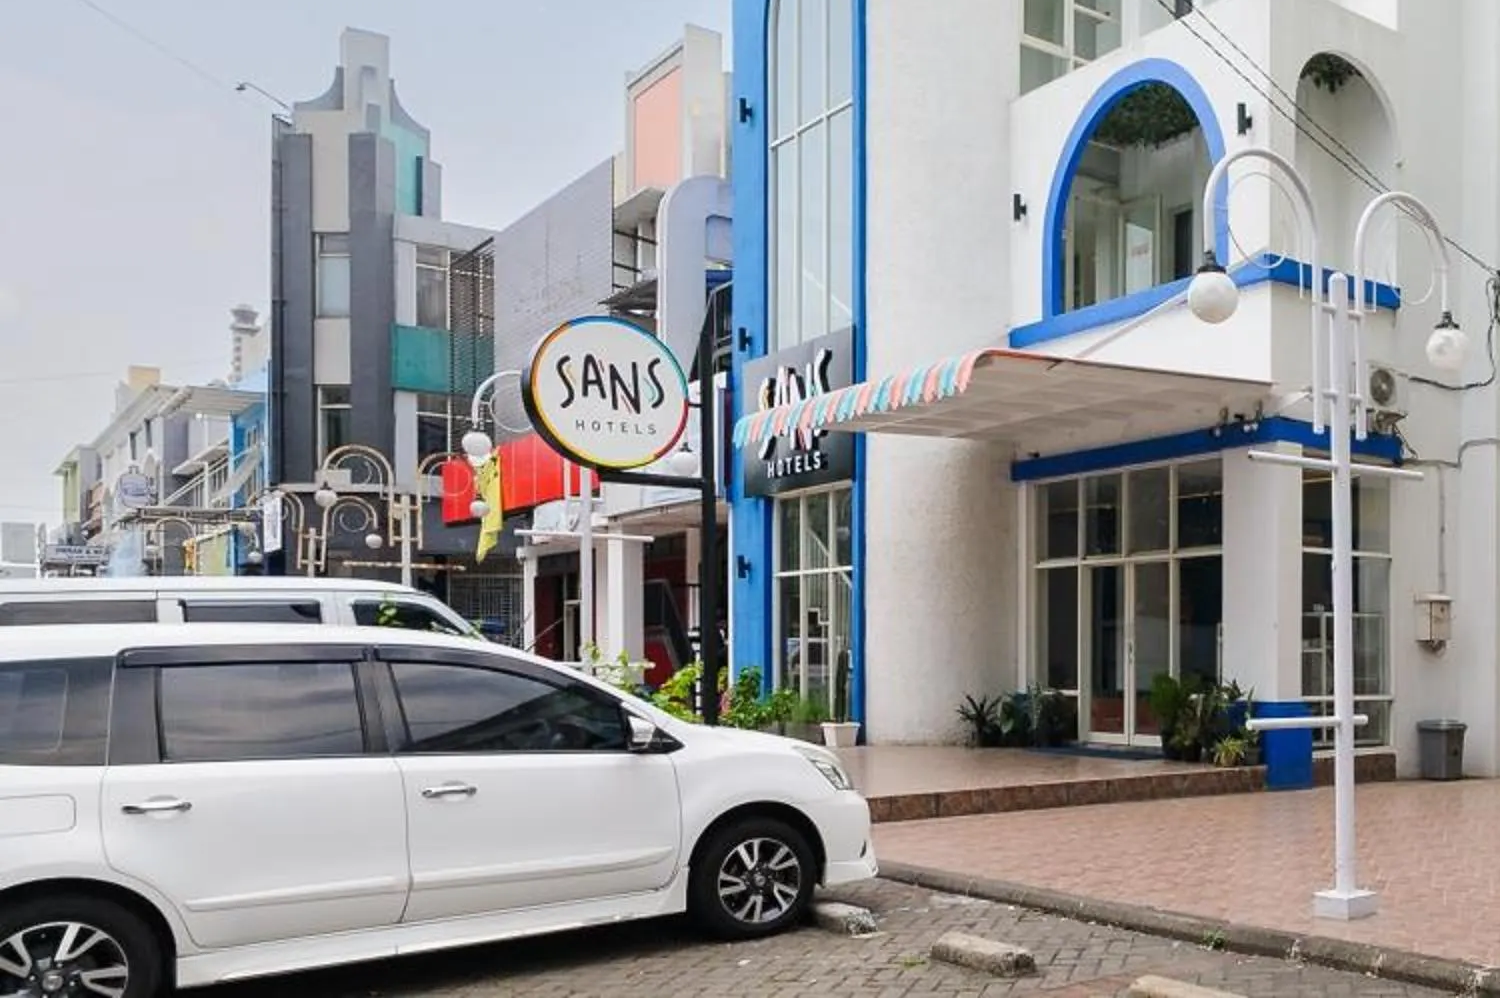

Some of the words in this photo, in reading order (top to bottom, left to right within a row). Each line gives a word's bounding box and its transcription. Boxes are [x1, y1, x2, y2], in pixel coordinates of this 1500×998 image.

[556, 354, 665, 415] SANS
[575, 419, 657, 435] HOTELS
[767, 451, 822, 479] HOTELS
